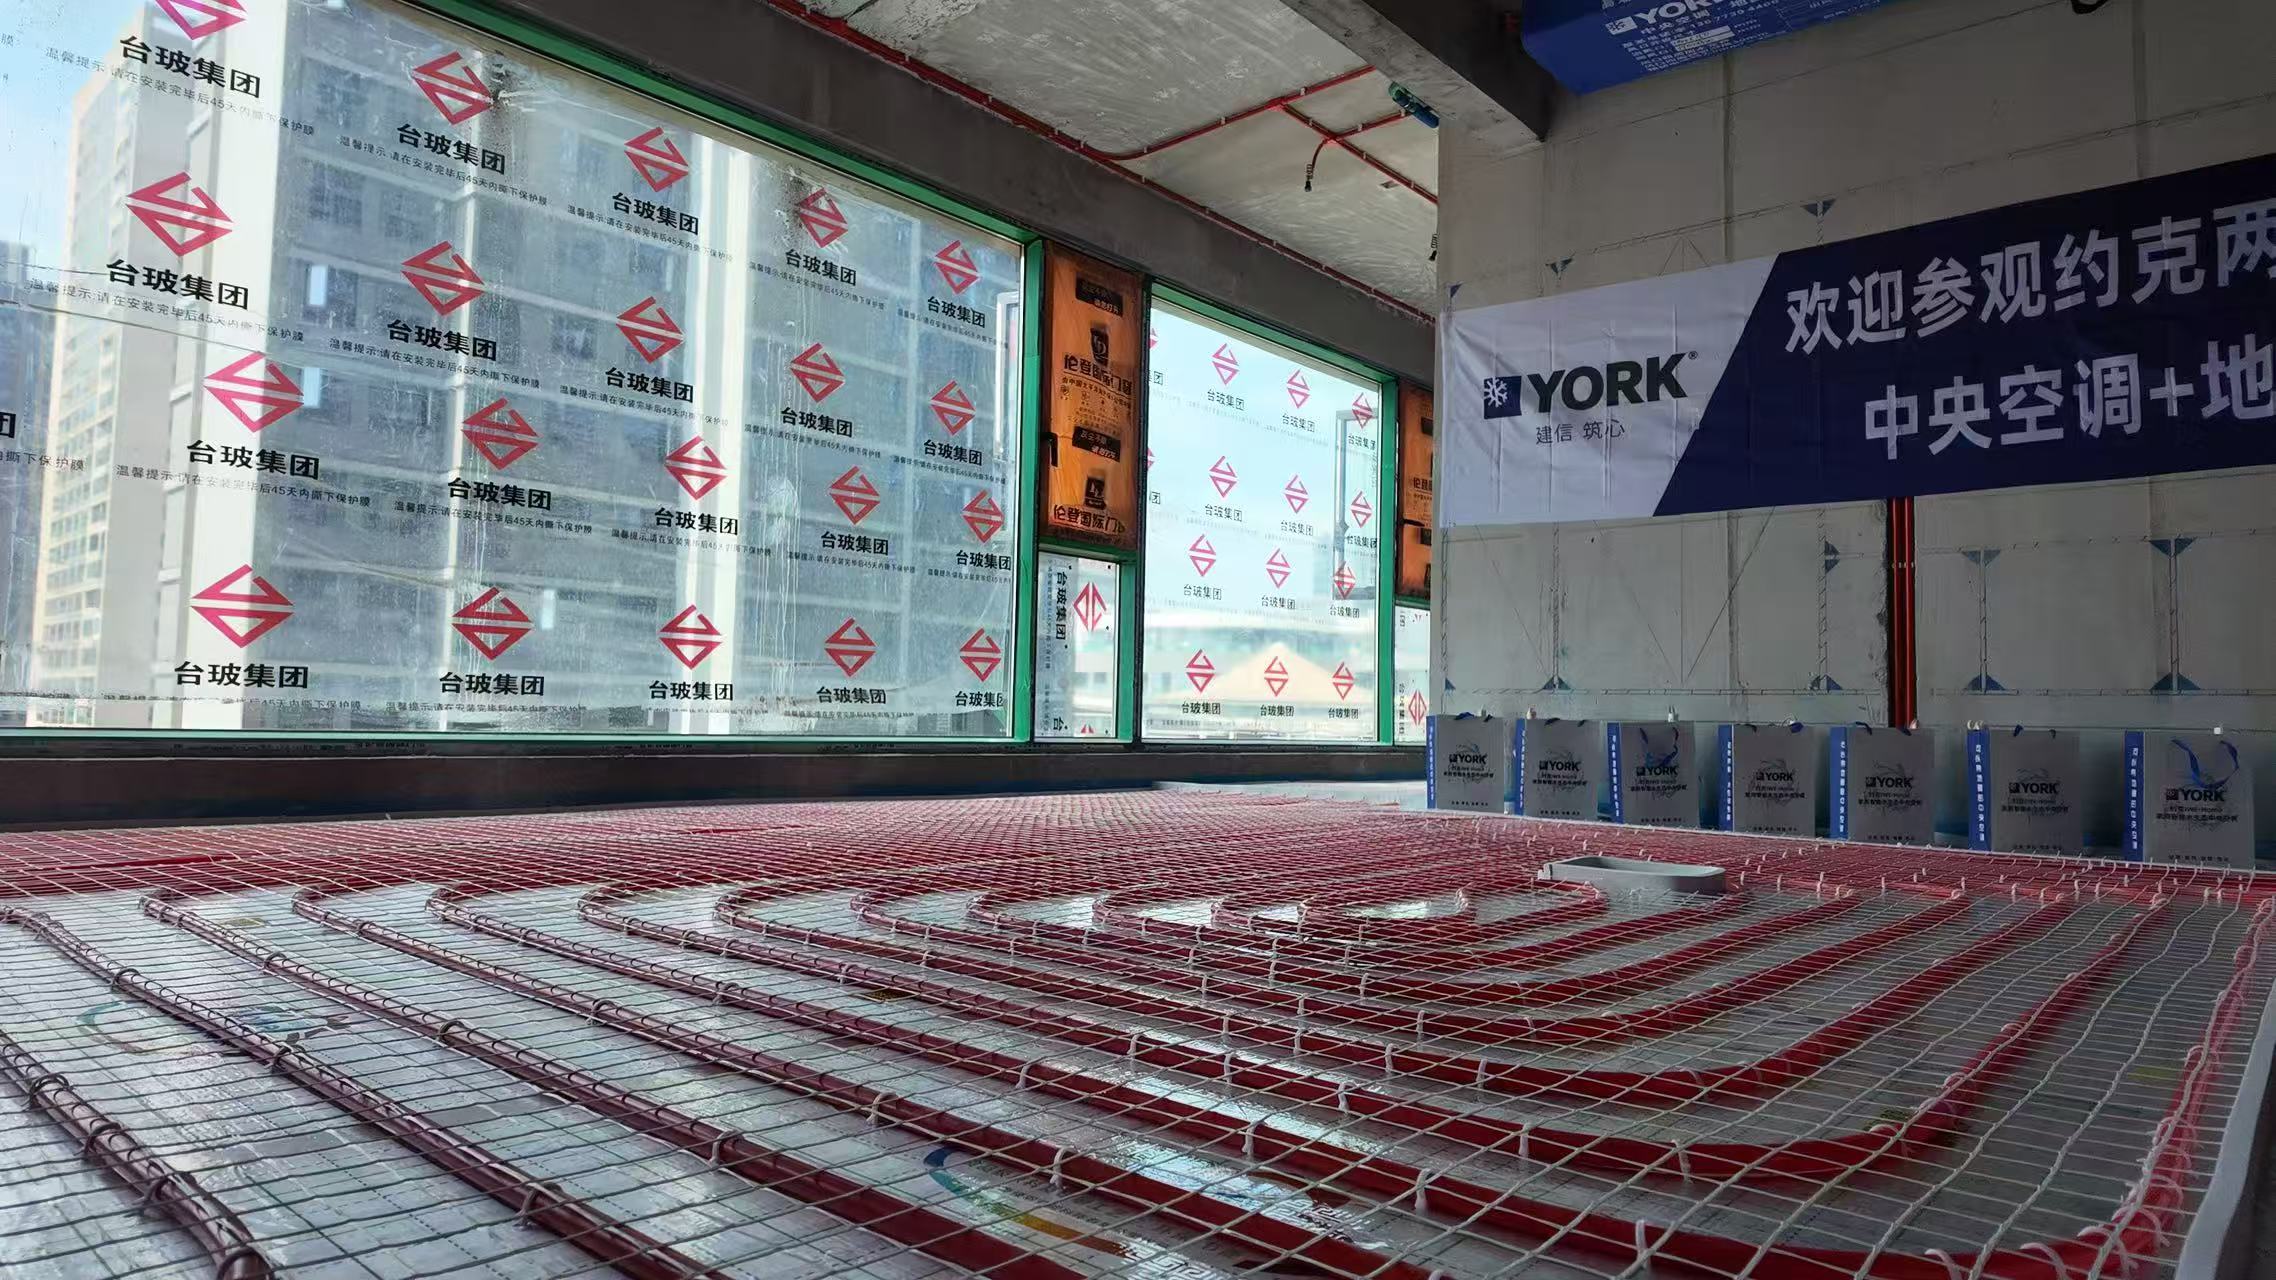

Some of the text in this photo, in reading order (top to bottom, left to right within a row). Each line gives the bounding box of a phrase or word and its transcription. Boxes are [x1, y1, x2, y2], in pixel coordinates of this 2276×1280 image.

[121, 36, 260, 97] 台玻集团
[397, 124, 505, 176] 台玻集团
[613, 193, 698, 238] 台玻集团
[784, 249, 856, 286] 台玻集团
[1783, 198, 2276, 355] 欢迎参观约克两
[107, 259, 248, 311] 台玻集团
[928, 296, 985, 328] 台玻集团
[387, 319, 496, 364] 台玻集团
[605, 367, 693, 405] 台玻集团
[1864, 333, 2276, 460] 中央空调+地
[781, 407, 852, 441] 台玻集团
[1535, 418, 1626, 445] 建信 筑心
[187, 440, 319, 484] 台玻集团
[924, 439, 982, 467] 台玻集团
[448, 478, 551, 510] 台玻集团
[655, 508, 737, 535] 台玻集团
[821, 531, 888, 555] 台玻集团
[956, 550, 1011, 570] 台玻集团
[1184, 584, 1221, 600] 台玻集团
[1262, 597, 1295, 609] 台玻集团
[1056, 571, 1068, 640] 台玻集团
[1330, 605, 1359, 618] 台玻集团
[175, 661, 308, 688] 台玻集团
[440, 672, 544, 696] 台玻集团
[650, 681, 733, 701] 台玻集团
[817, 687, 886, 704] 台玻集团
[1182, 702, 1220, 714] 台玻集团
[1260, 705, 1294, 716] 台玻集团
[1328, 708, 1358, 718] 台玻集团
[1459, 754, 1488, 765] YORK
[1549, 761, 1582, 772] YORK
[1648, 766, 1679, 776] YORK
[1766, 772, 1794, 781] YORK
[1875, 776, 1914, 788] YORK
[2021, 782, 2060, 794] YORK
[2180, 788, 2225, 802] YORK
